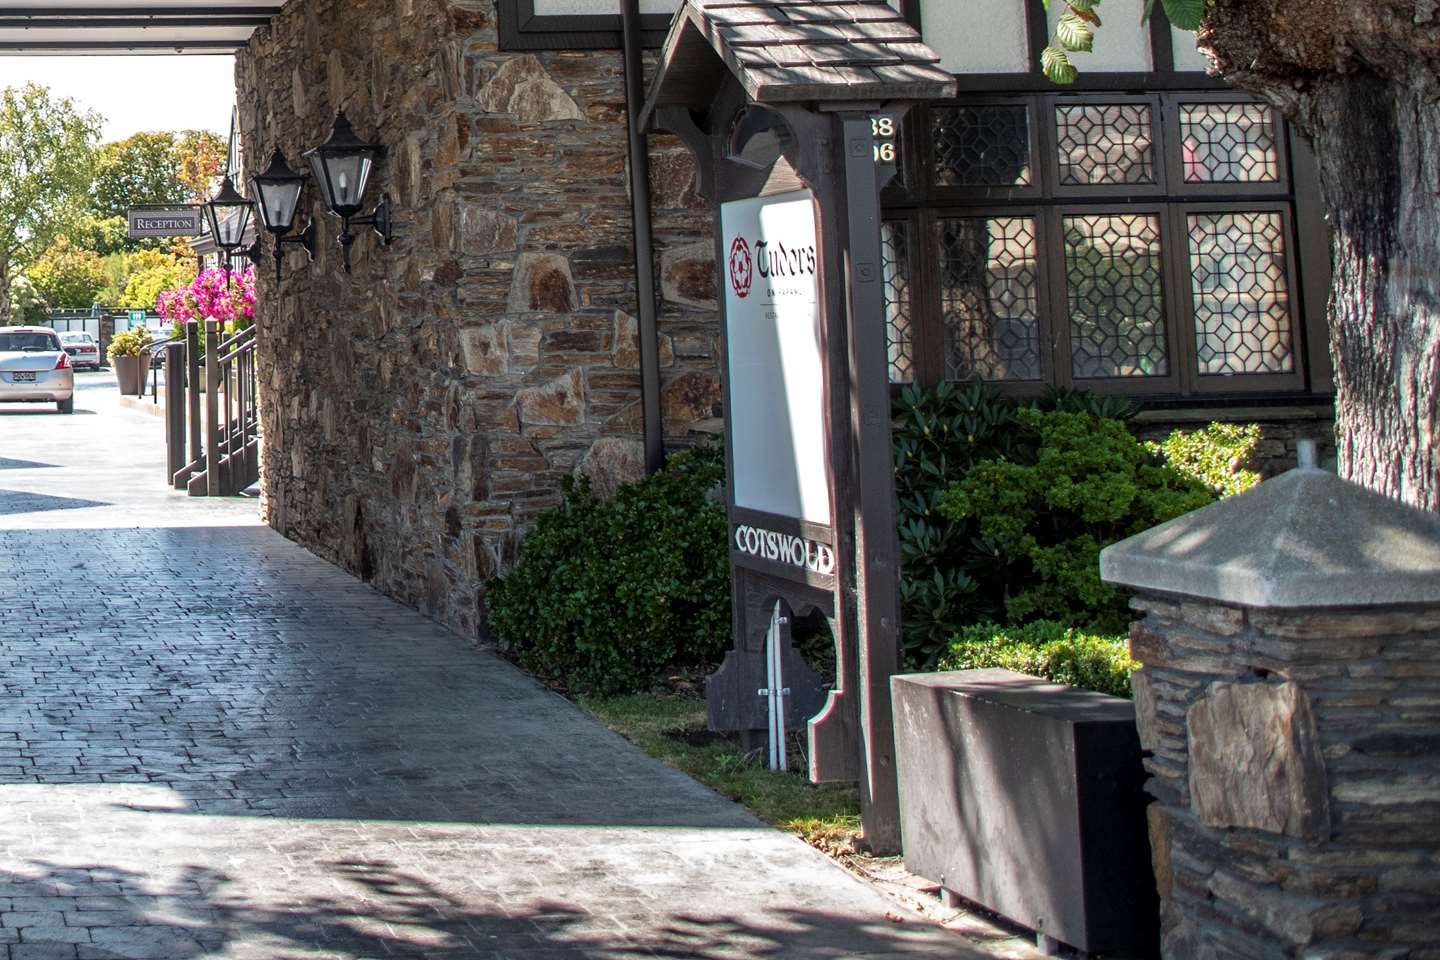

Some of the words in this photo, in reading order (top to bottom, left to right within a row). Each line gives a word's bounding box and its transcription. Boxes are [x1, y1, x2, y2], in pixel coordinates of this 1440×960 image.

[137, 218, 192, 229] RECEPTION
[754, 239, 816, 279] Tudors
[734, 524, 835, 575] COTSWOLD
